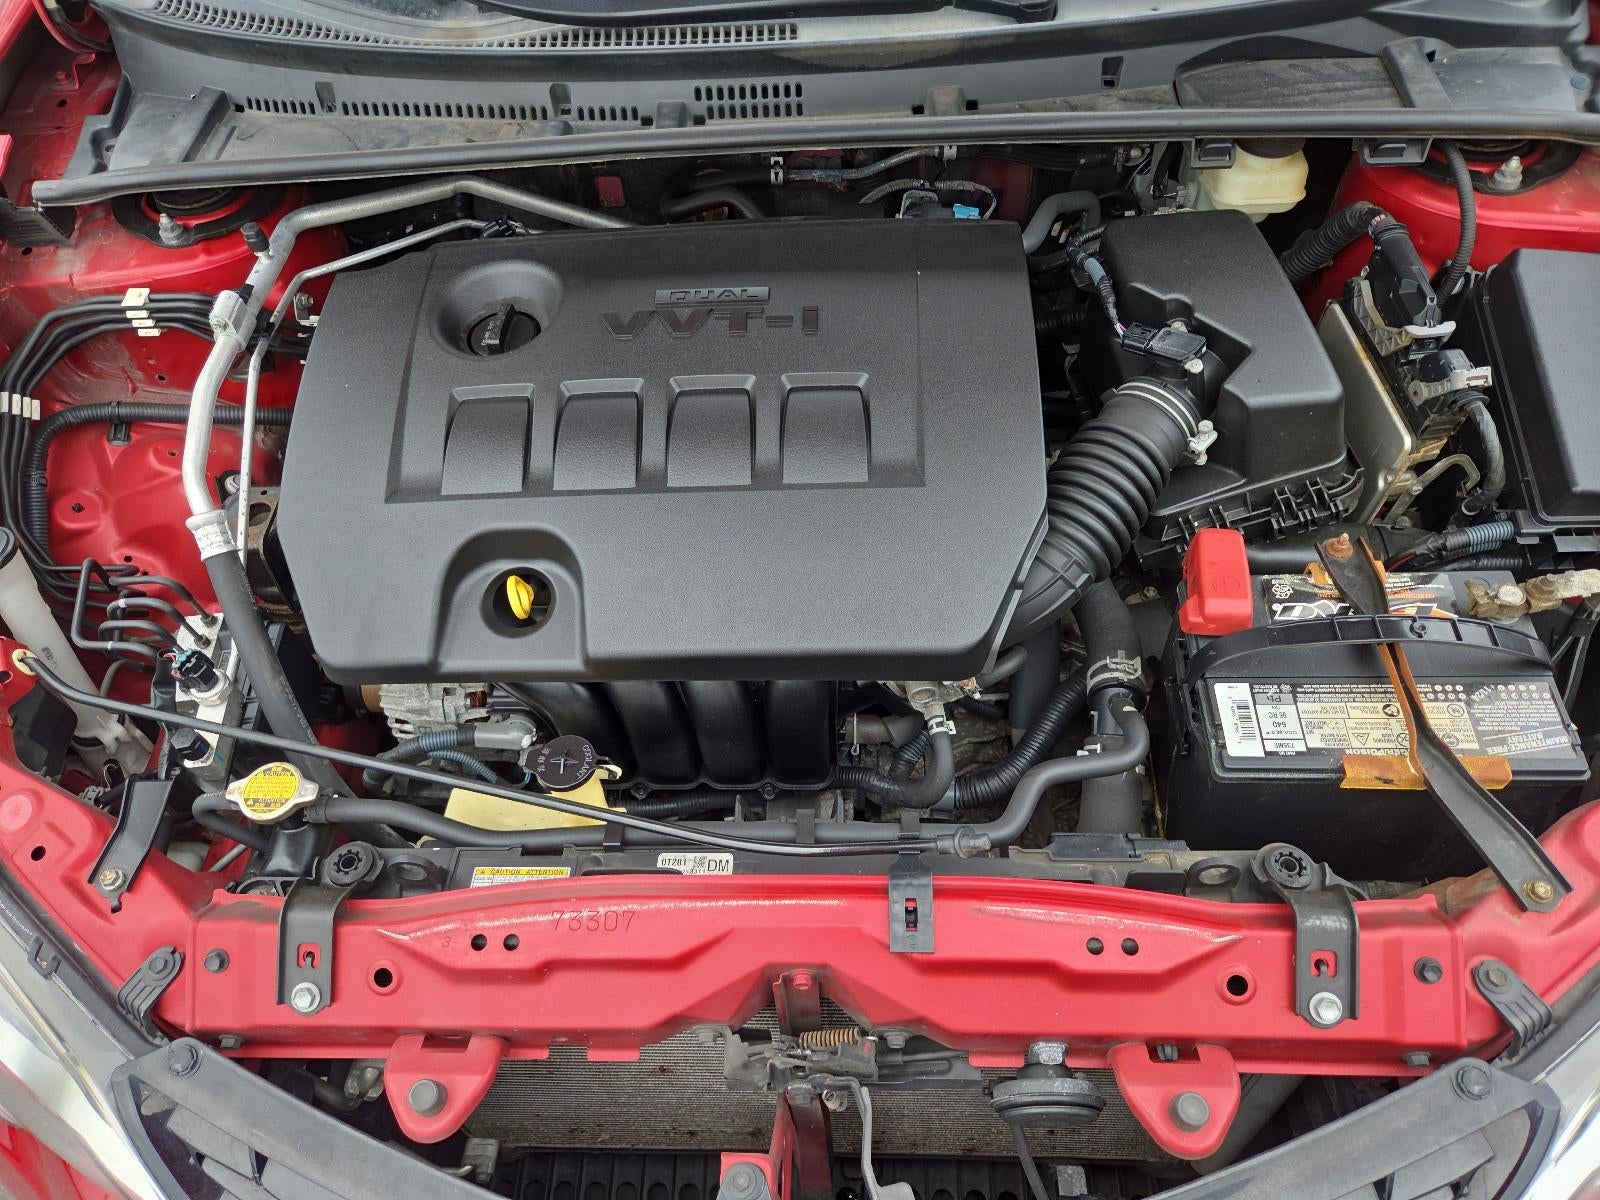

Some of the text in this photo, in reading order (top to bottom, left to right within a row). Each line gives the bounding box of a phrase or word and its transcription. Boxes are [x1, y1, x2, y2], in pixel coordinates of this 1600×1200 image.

[669, 288, 760, 302] DUAL
[1266, 695, 1282, 703] Pb
[1267, 711, 1278, 719] RC
[1507, 731, 1544, 744] BATTERY
[1486, 735, 1569, 755] MAINTENANCE-FREE
[1345, 748, 1409, 756] GER/POISON
[576, 744, 593, 781] COOLANT
[707, 859, 729, 872] DM
[551, 910, 637, 933] 73307
